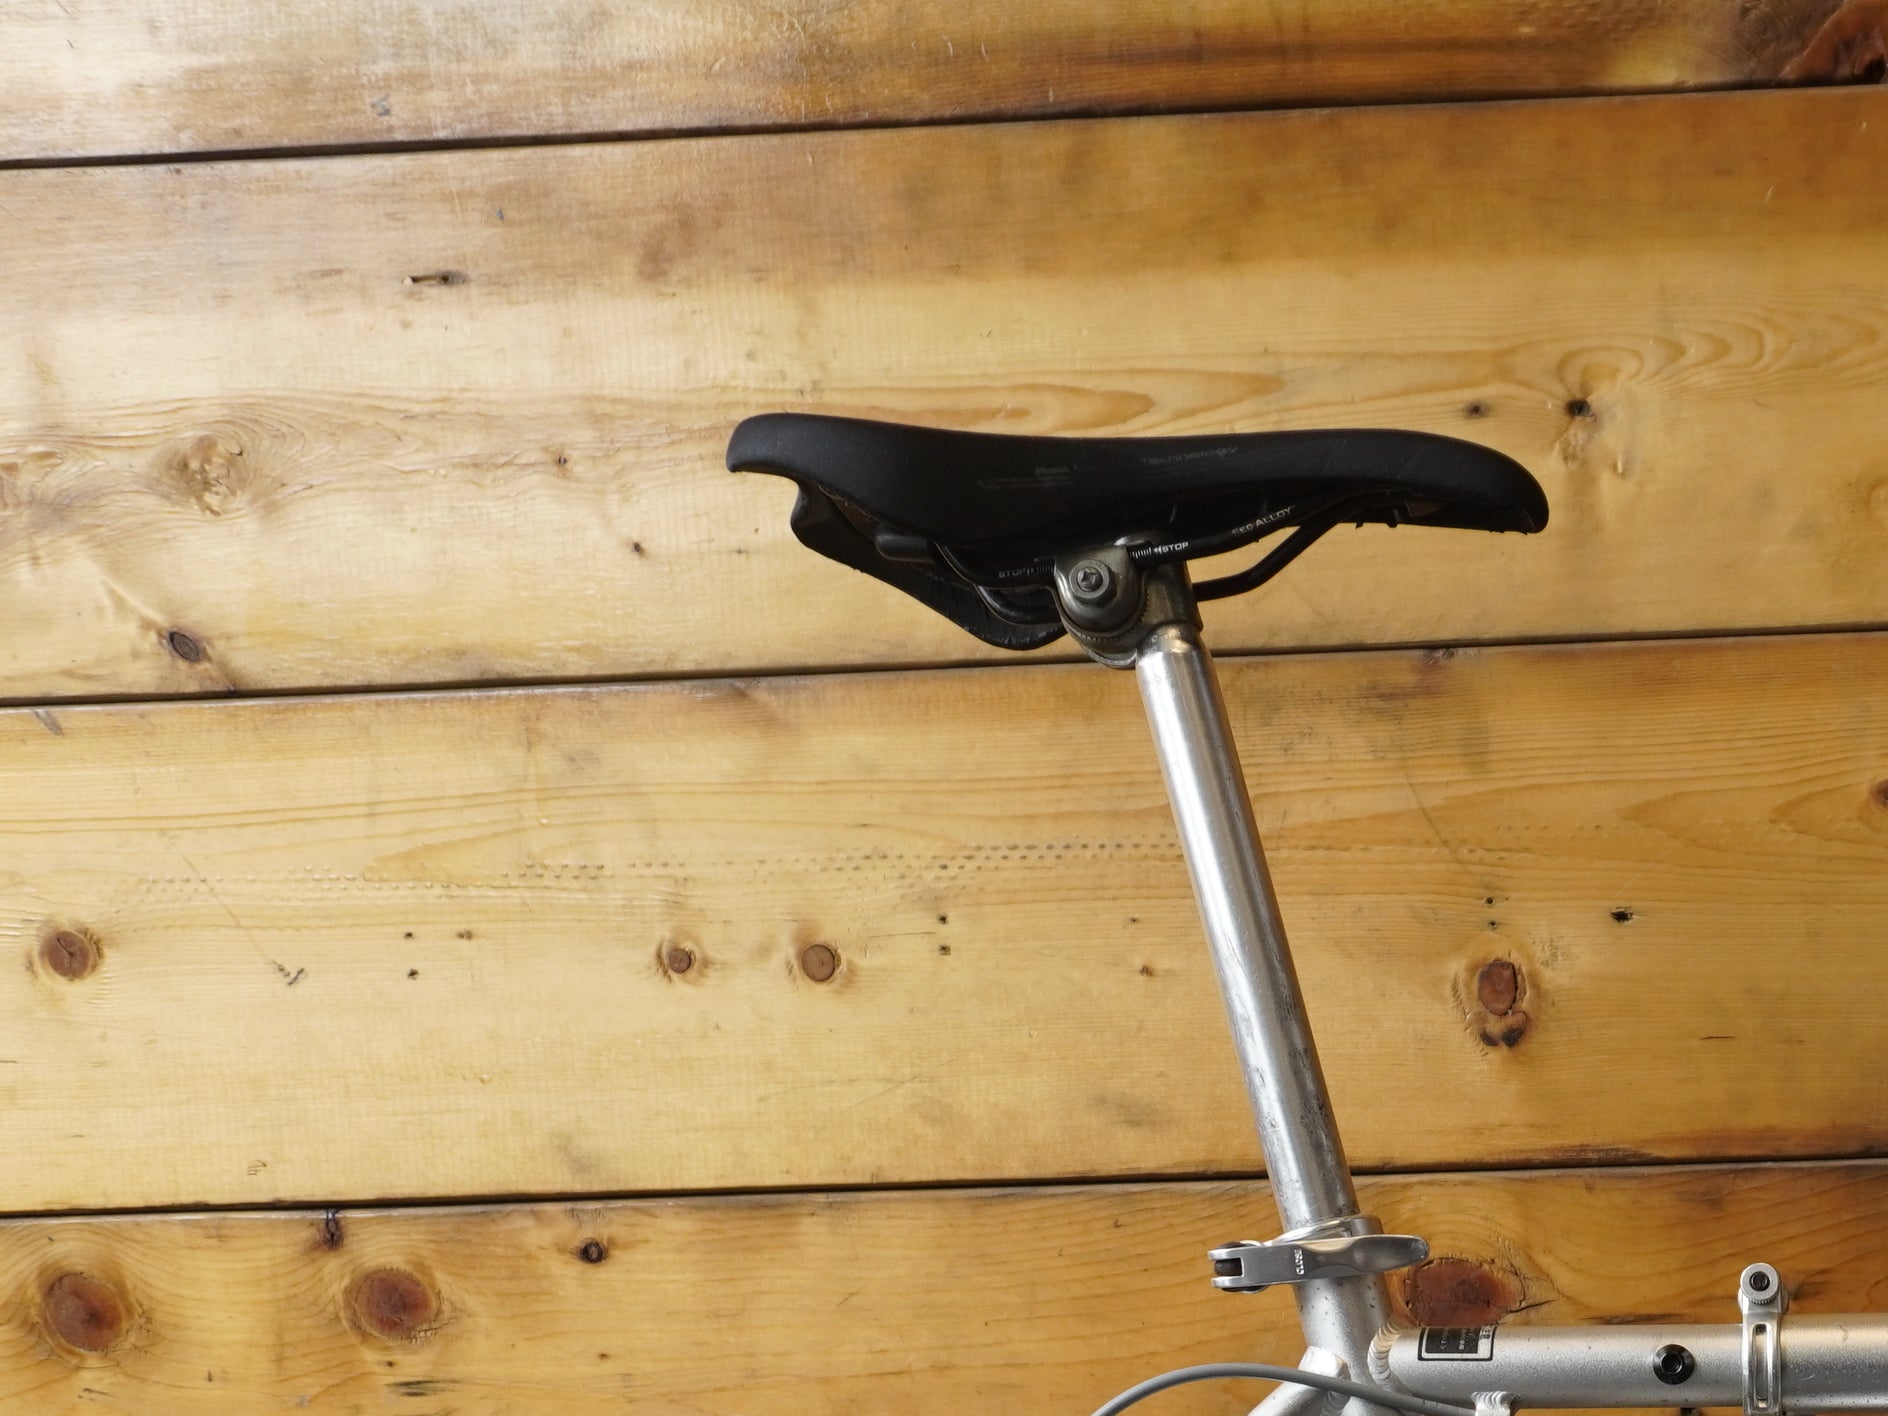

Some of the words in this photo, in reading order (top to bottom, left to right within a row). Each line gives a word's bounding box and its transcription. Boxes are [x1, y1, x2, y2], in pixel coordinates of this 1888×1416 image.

[1256, 506, 1291, 528] ALLOY
[1161, 541, 1189, 553] STOP
[998, 567, 1026, 578] STOP
